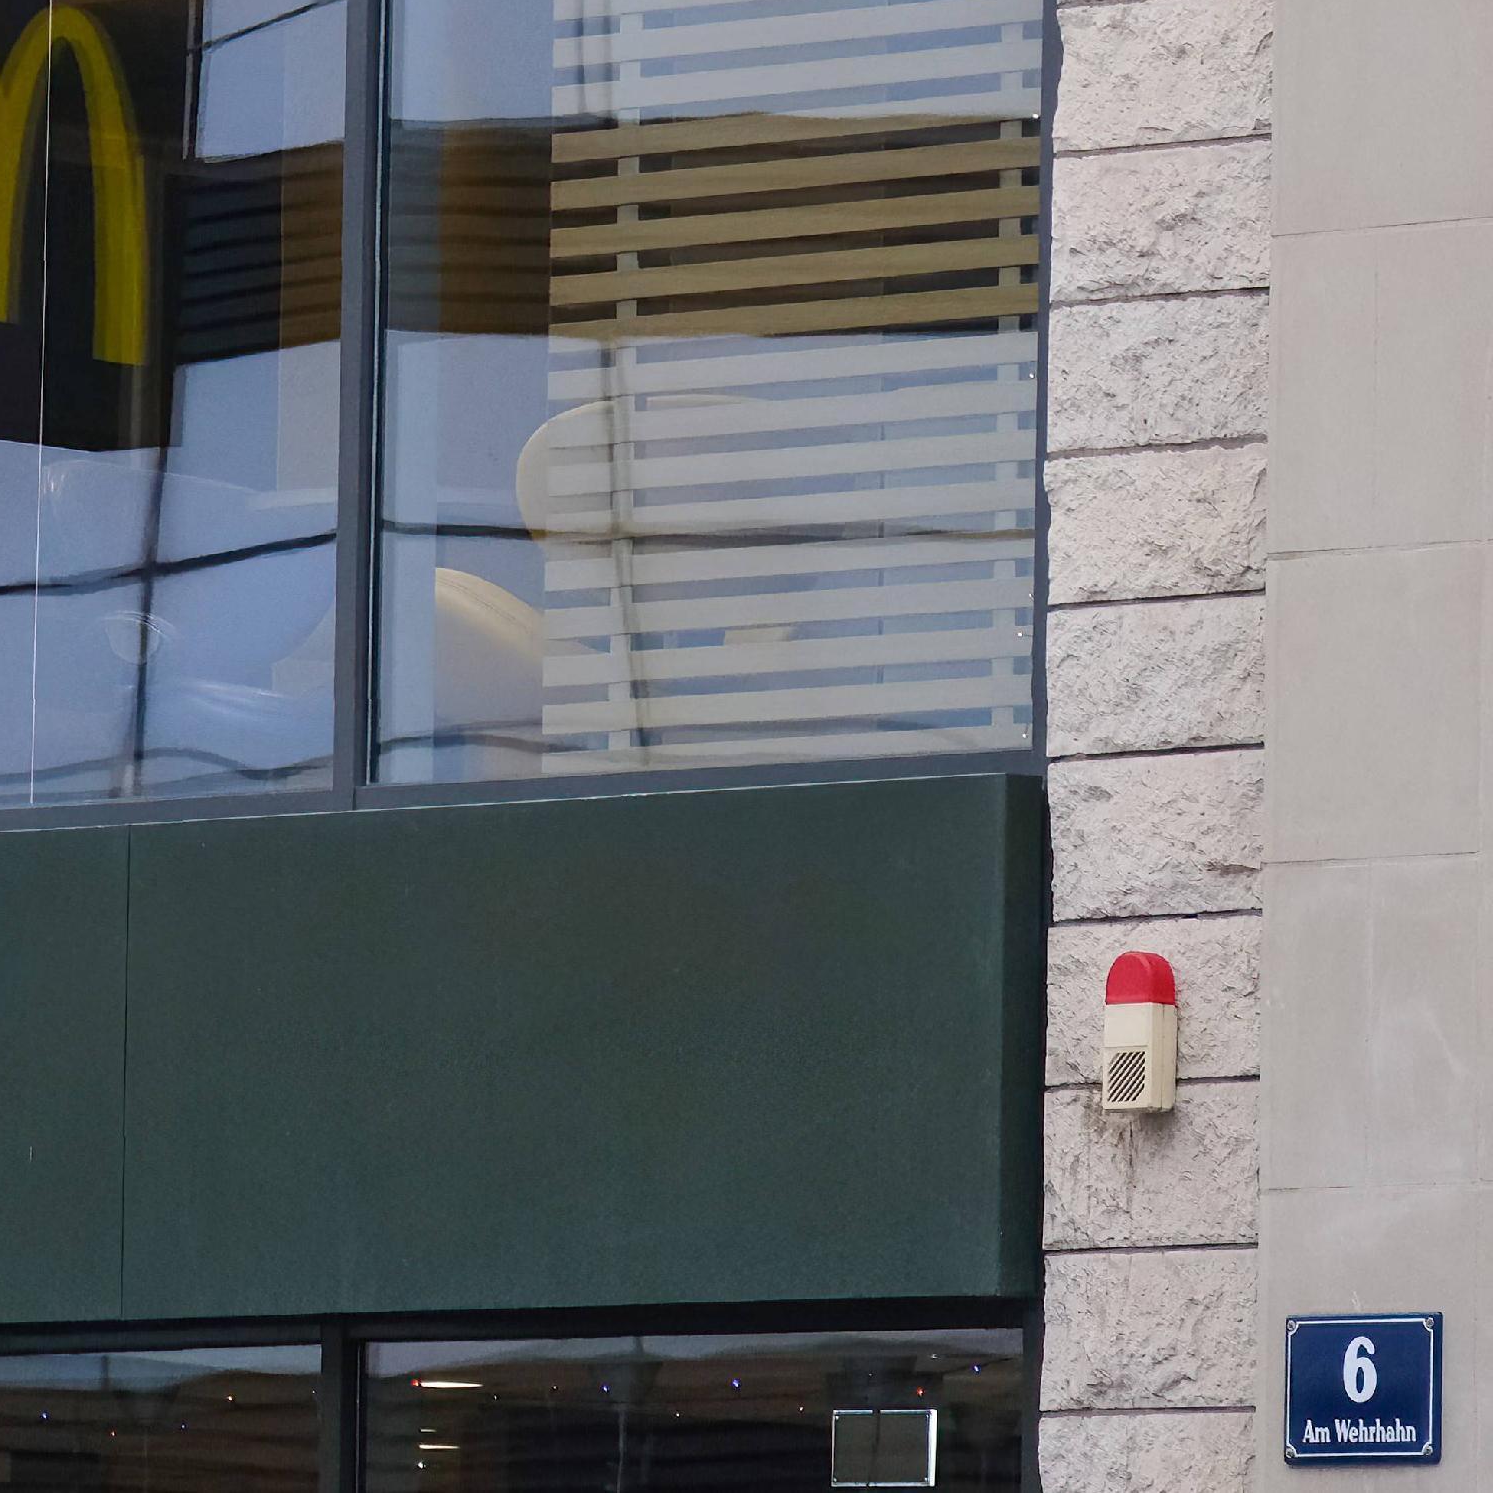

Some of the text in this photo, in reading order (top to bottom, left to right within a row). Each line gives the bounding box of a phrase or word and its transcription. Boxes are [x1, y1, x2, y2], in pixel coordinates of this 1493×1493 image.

[1343, 1336, 1377, 1403] 6
[1302, 1418, 1417, 1443] Am Wehrhahn
